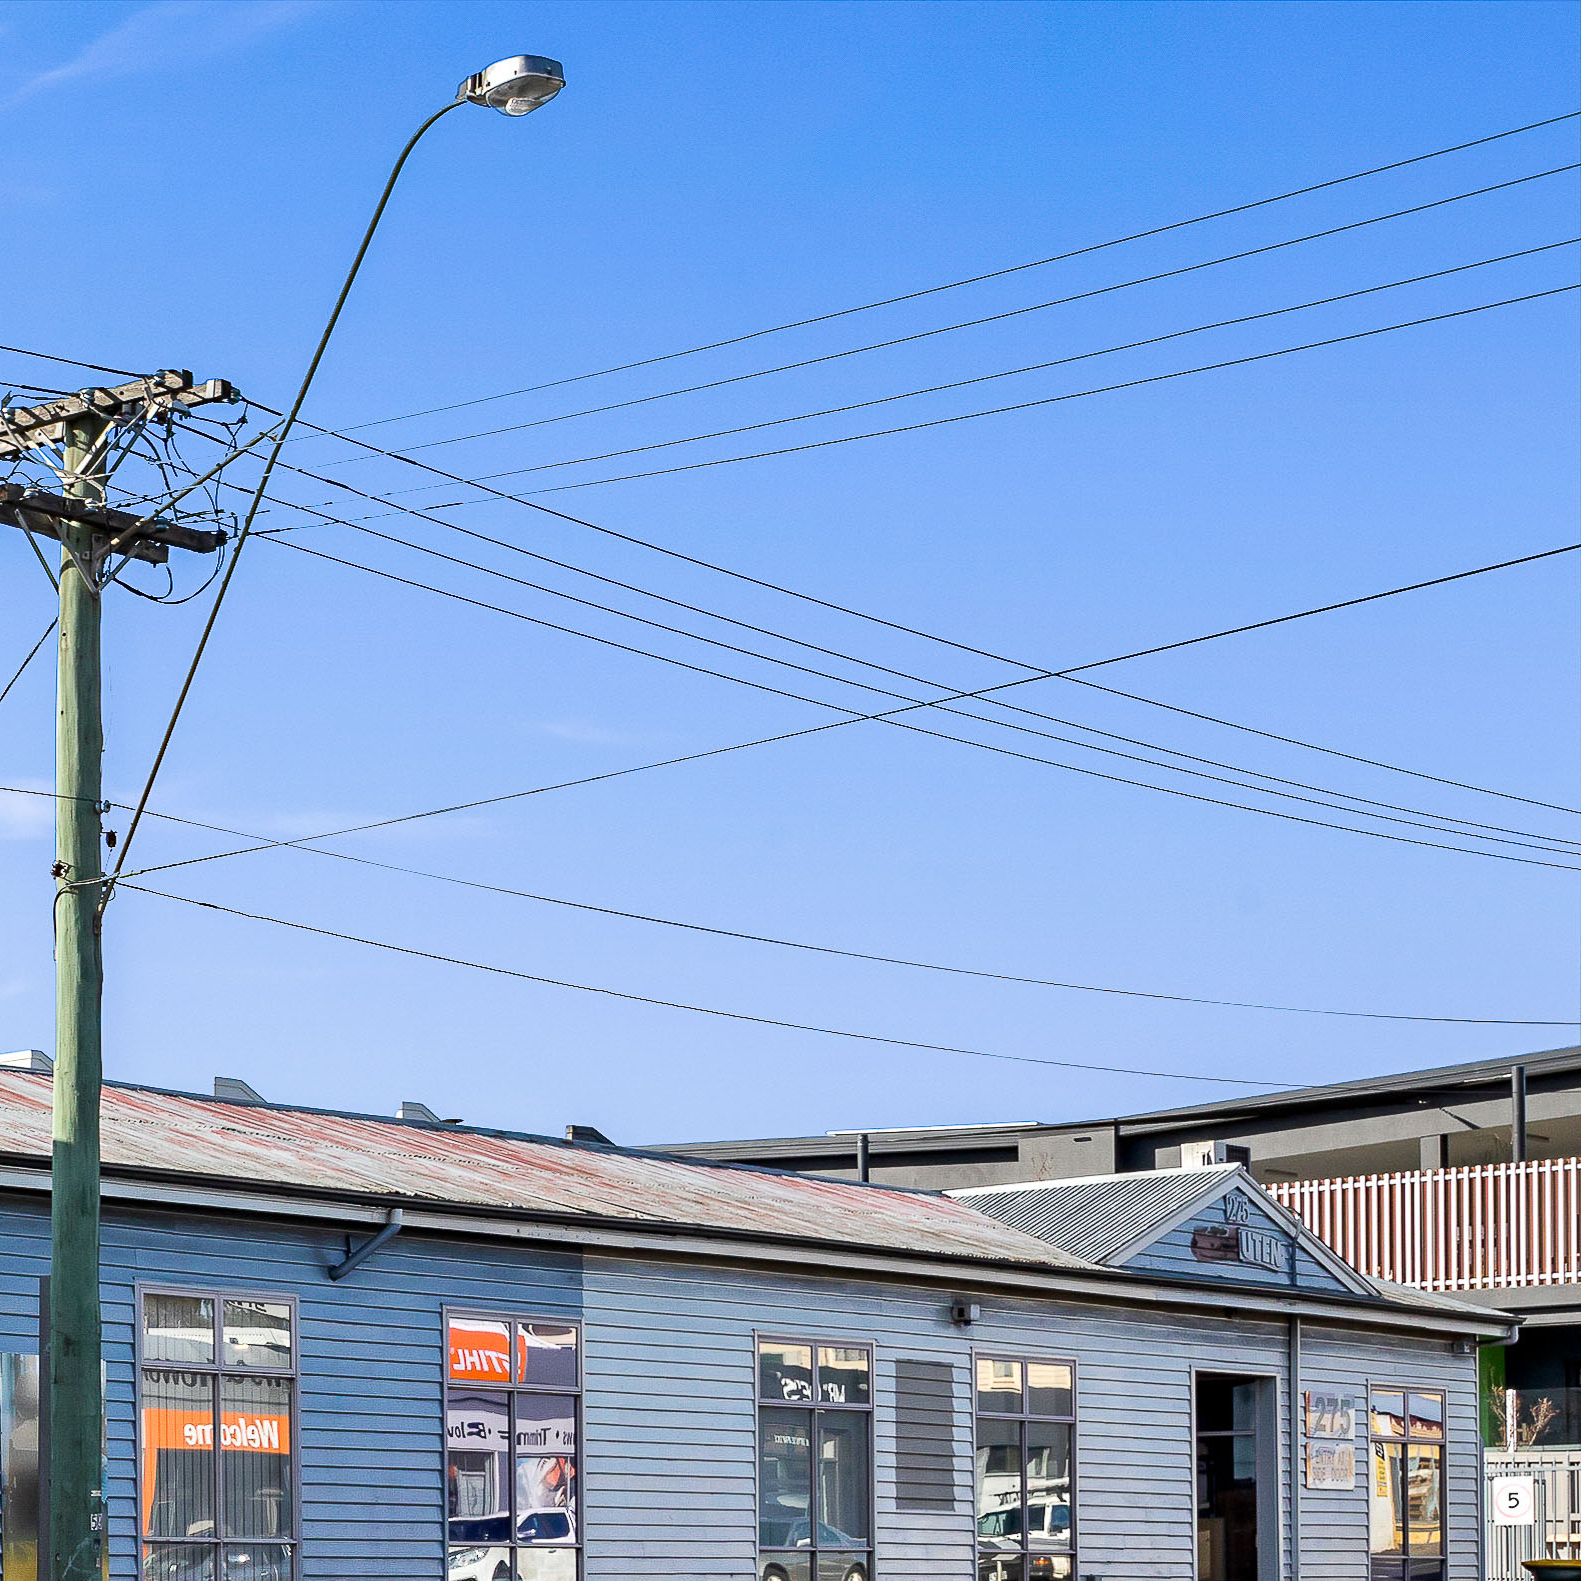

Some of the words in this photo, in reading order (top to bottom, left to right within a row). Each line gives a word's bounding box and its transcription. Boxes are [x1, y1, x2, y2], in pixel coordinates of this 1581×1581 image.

[1226, 1195, 1250, 1223] 275
[1315, 1397, 1350, 1434] 275
[1508, 1492, 1520, 1509] 5
